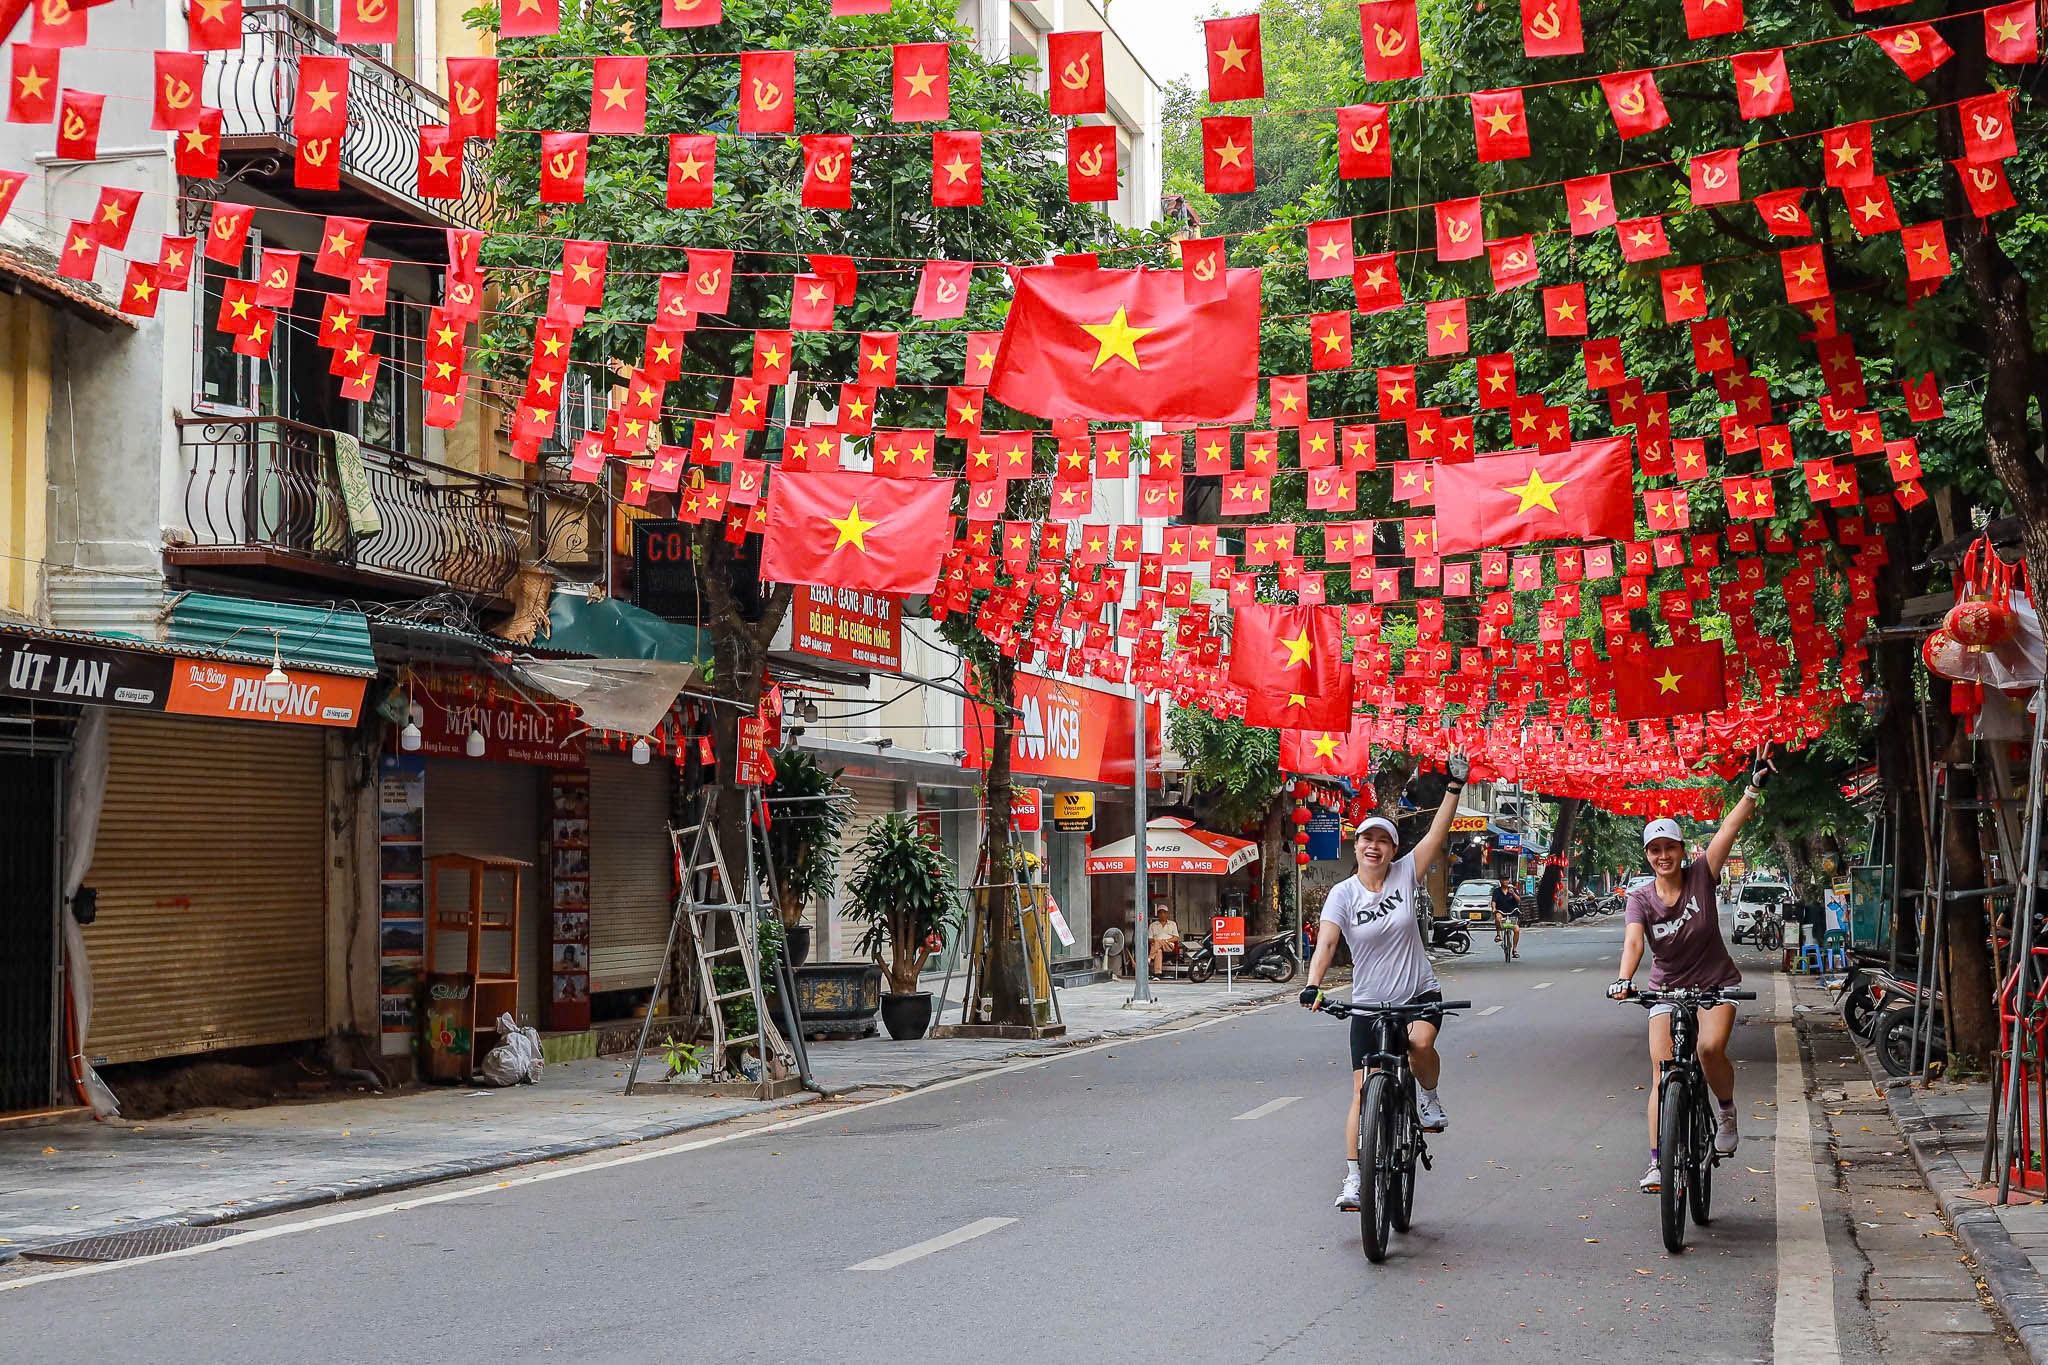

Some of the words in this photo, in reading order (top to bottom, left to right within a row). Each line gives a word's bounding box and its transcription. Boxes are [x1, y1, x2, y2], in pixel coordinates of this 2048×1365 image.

[9, 643, 51, 691] ÚT
[53, 656, 111, 698] LAN
[190, 665, 205, 682] Thú
[206, 667, 227, 689] Bông
[445, 704, 492, 740] MAIN
[497, 710, 555, 745] OFFICE
[1047, 704, 1080, 760] MSB
[1017, 806, 1036, 814] MSB
[1106, 861, 1124, 869] MSB
[1151, 861, 1169, 869] MSB
[1194, 862, 1213, 870] MSB
[1215, 919, 1225, 932] P
